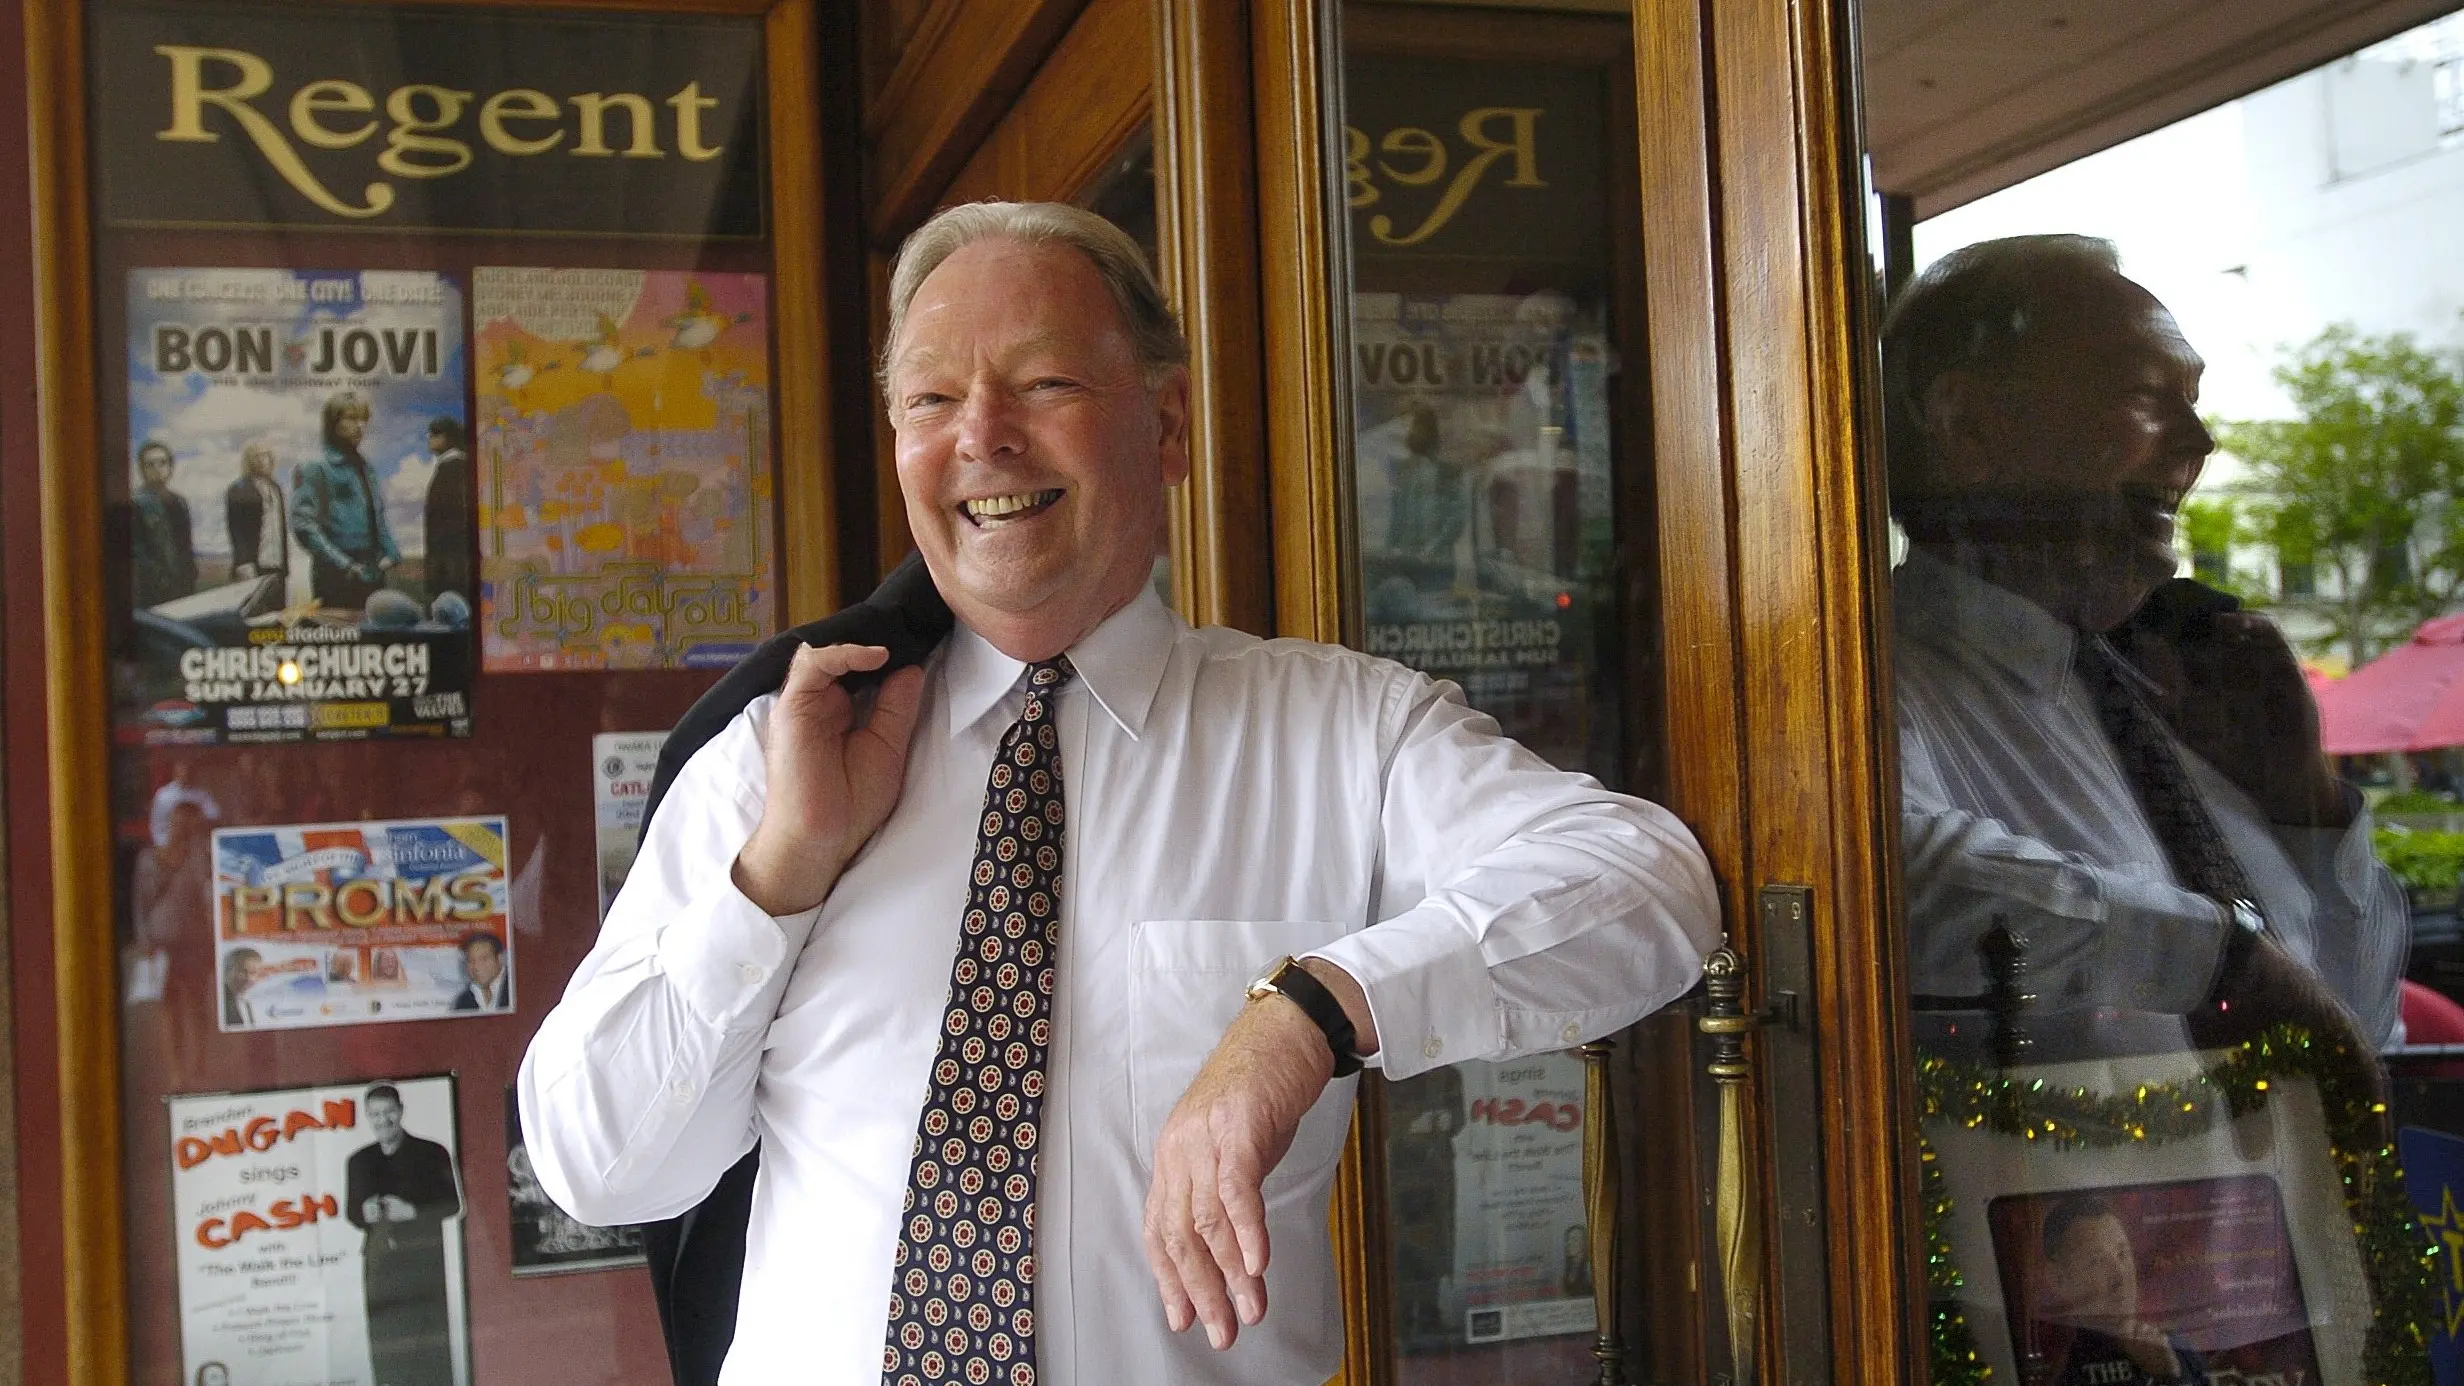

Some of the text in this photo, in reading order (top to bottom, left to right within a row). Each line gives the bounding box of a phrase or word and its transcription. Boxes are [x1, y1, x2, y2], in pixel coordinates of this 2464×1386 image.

[154, 45, 723, 218] Regent
[157, 327, 439, 375] BON JOVI
[180, 643, 430, 681] CHRISTCHURCH
[184, 679, 243, 702] SUN
[251, 677, 387, 701] JANUARY
[392, 676, 429, 697] 27
[231, 872, 495, 932] PROMS
[177, 1098, 356, 1171] DUGAN
[239, 1163, 301, 1184] sings
[195, 1194, 339, 1249] CASH
